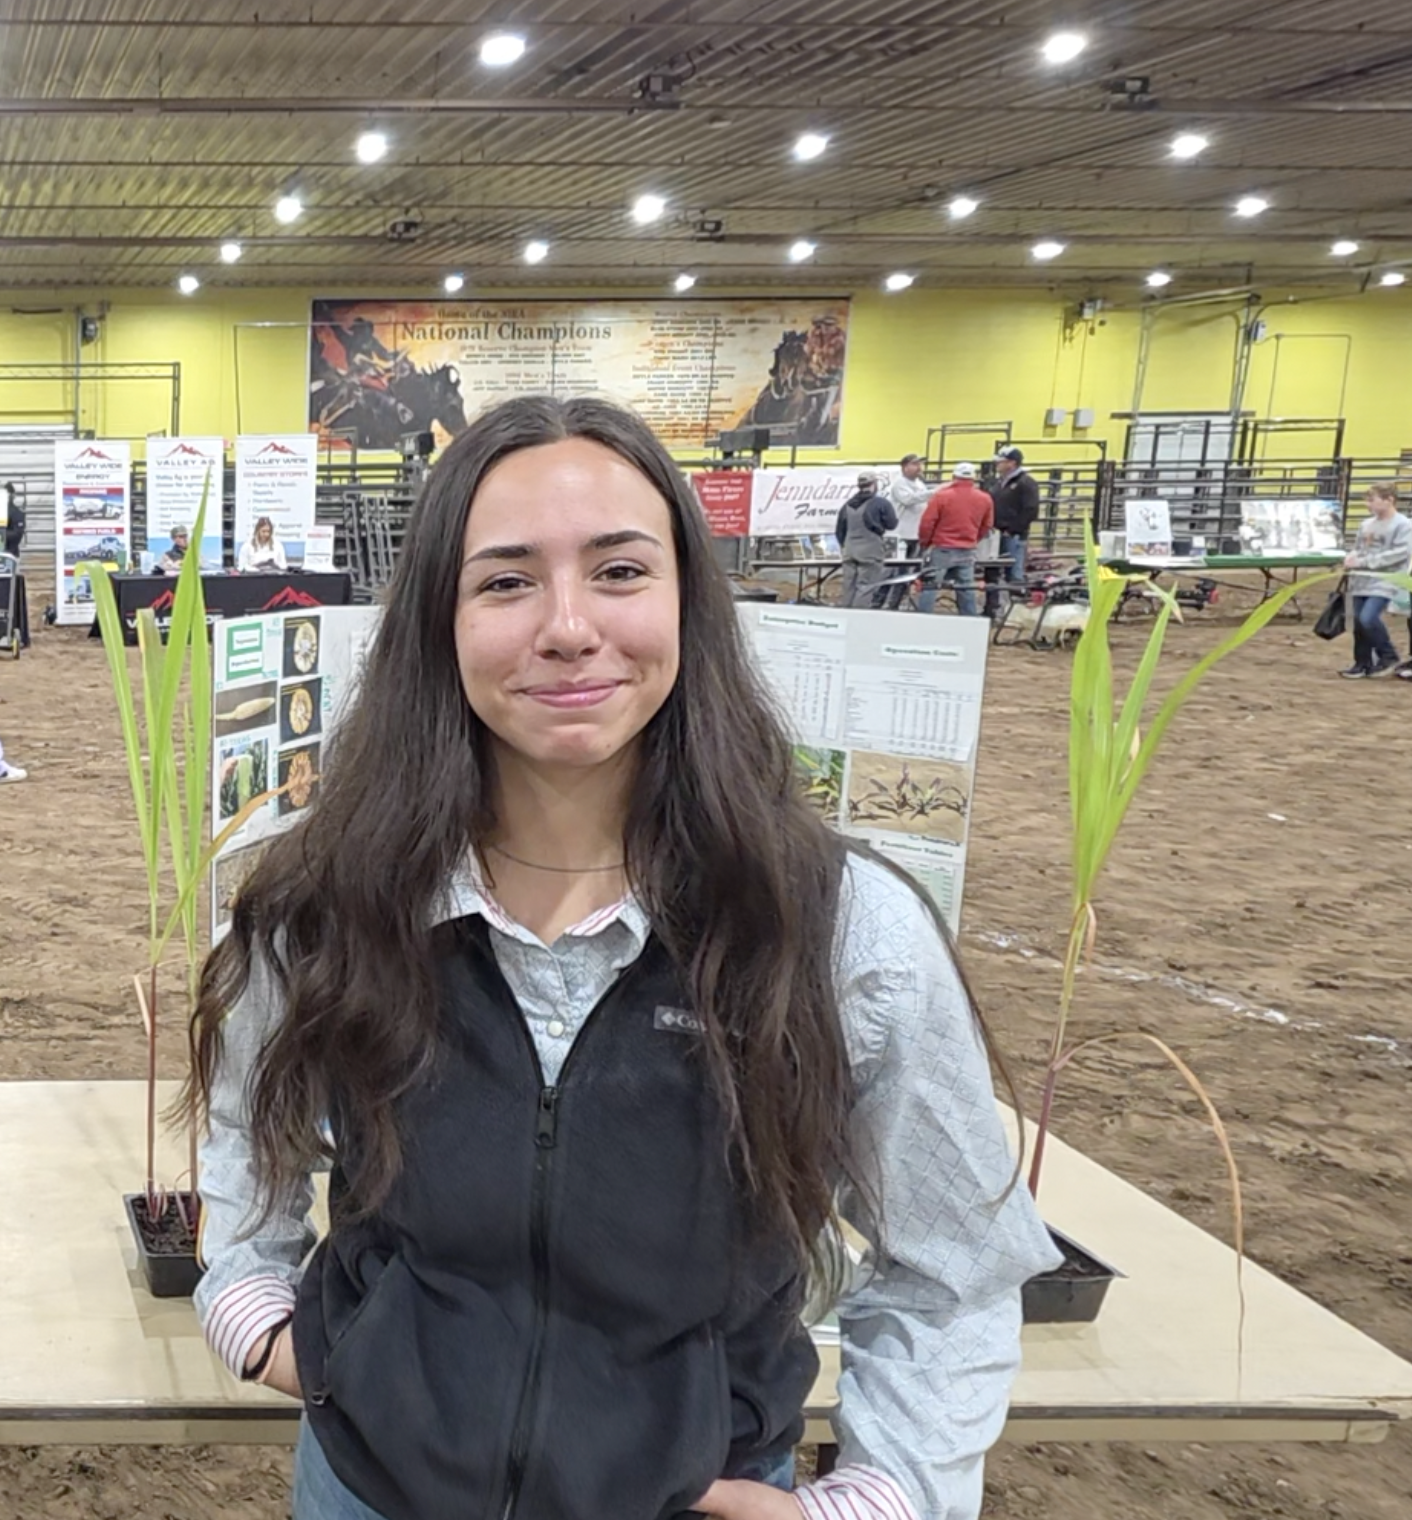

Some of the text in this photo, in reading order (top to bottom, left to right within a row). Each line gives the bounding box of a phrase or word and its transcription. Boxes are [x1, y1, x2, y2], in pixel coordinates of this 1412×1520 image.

[401, 321, 612, 343] National Champions
[794, 503, 838, 520] Farm
